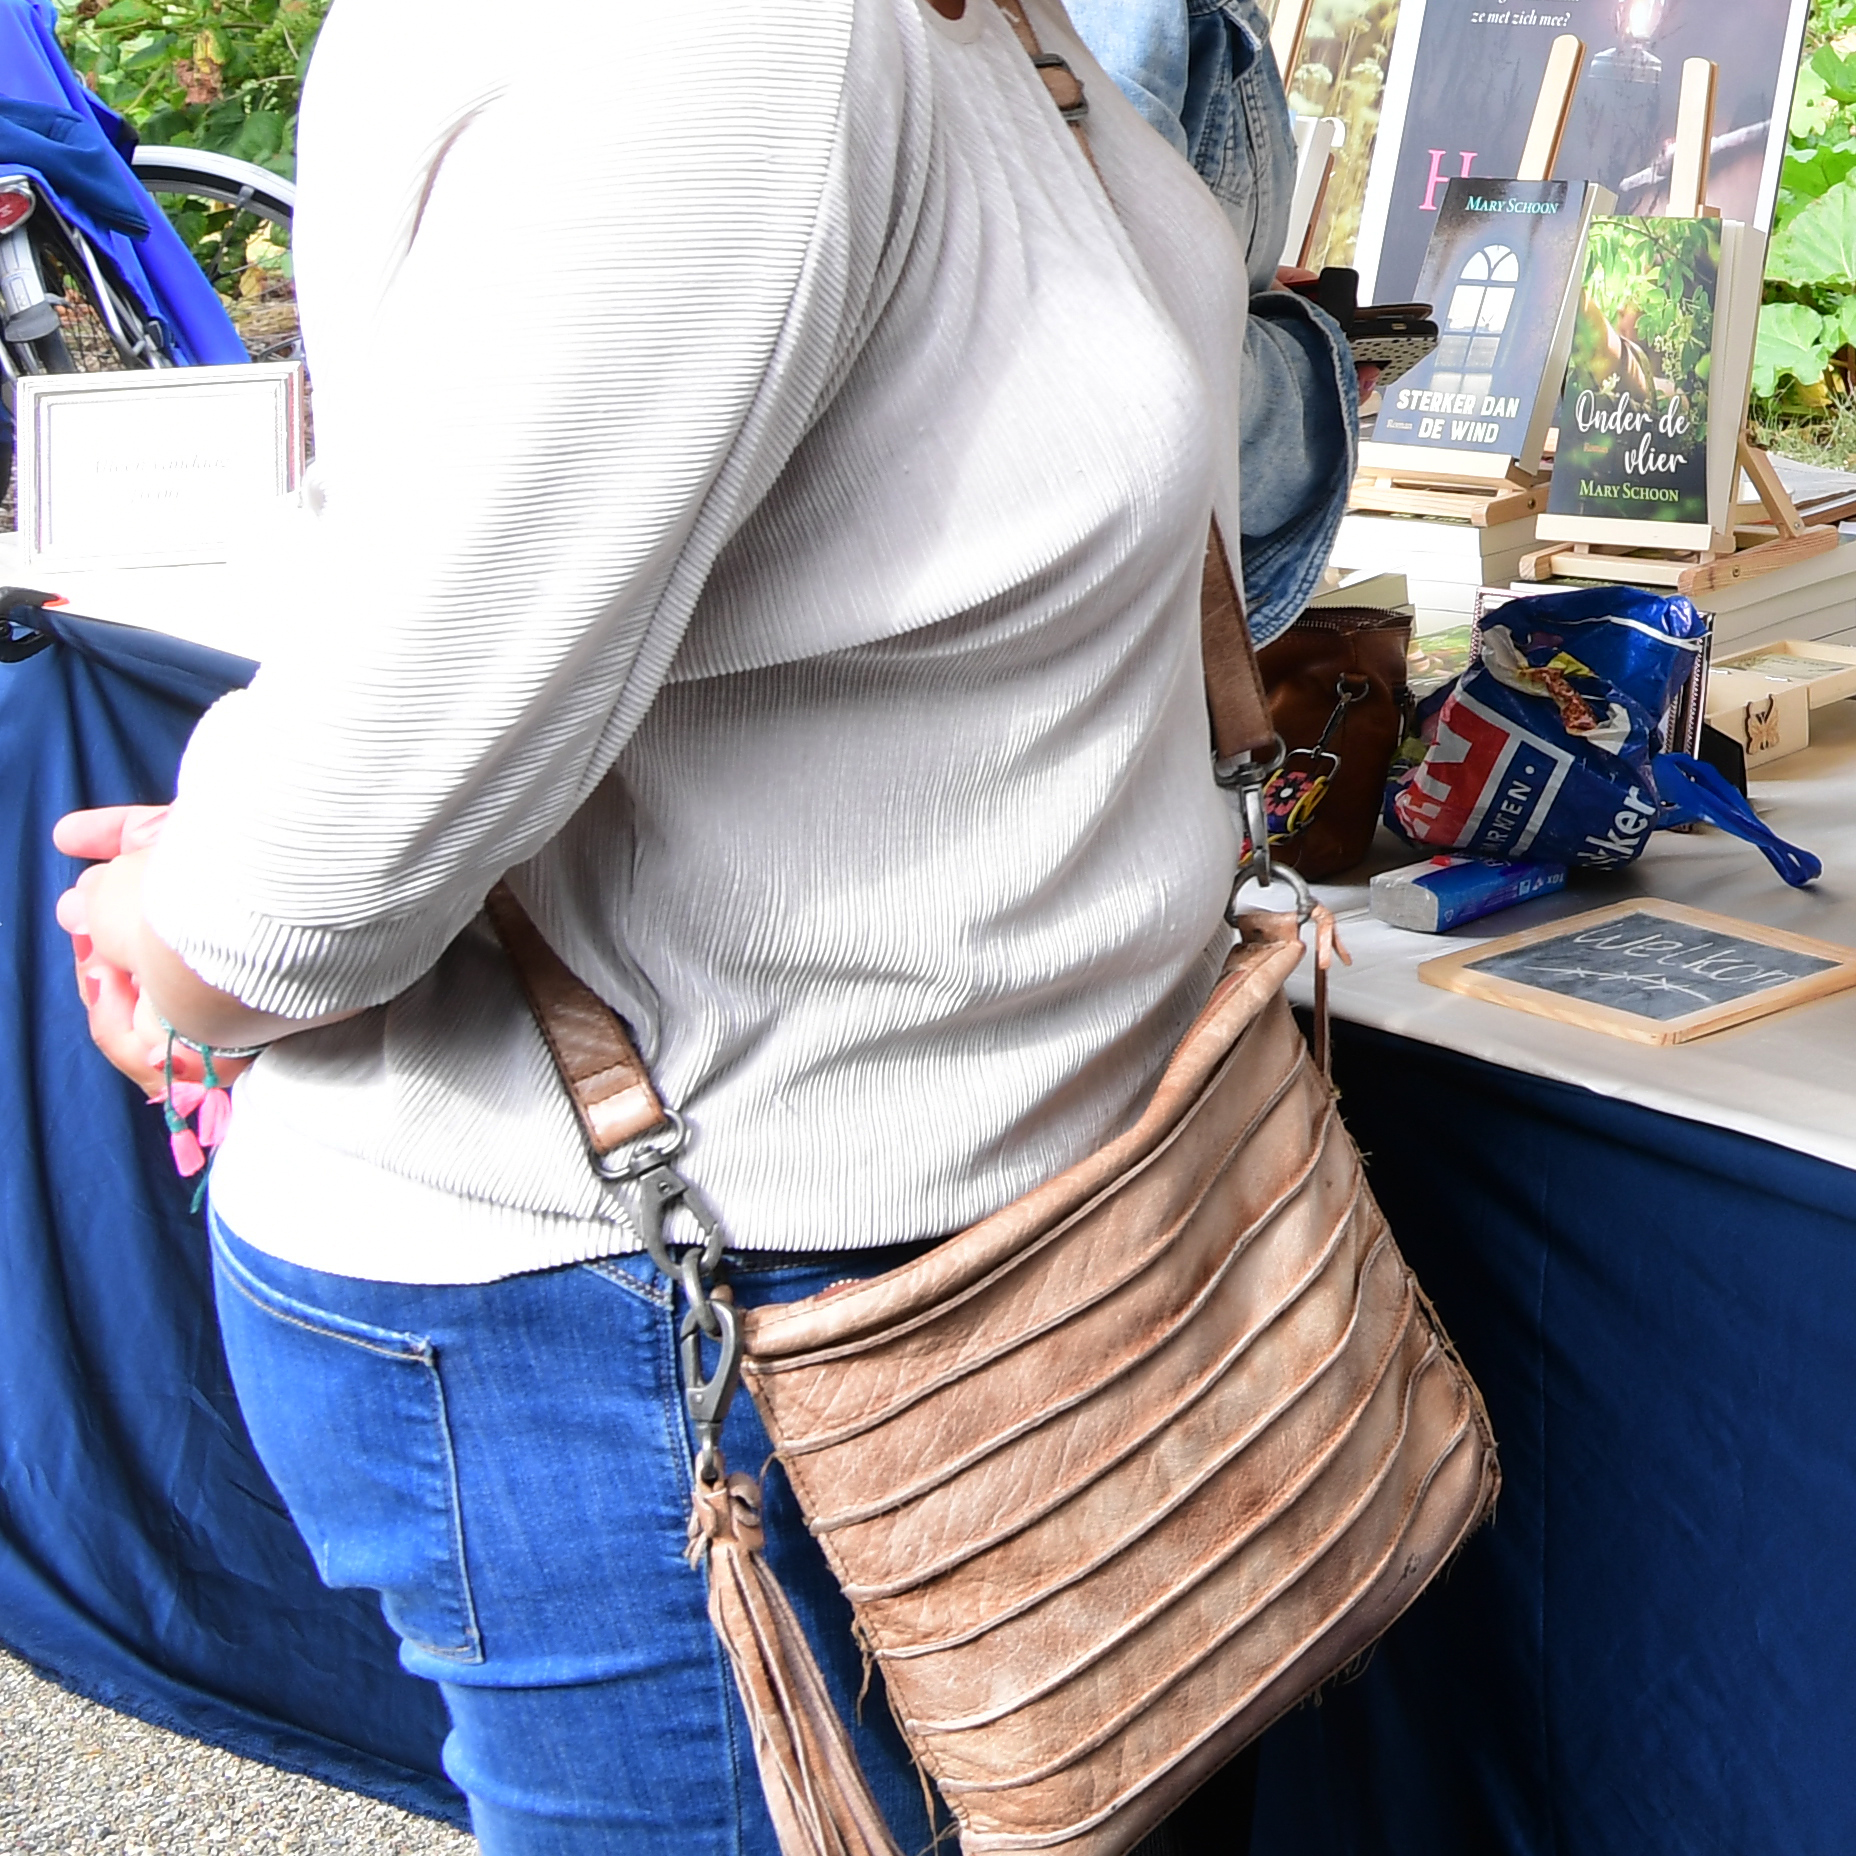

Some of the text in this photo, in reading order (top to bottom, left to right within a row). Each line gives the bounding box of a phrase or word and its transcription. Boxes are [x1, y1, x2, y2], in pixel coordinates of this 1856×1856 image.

[1470, 8, 1571, 27] ze met zich mee?
[1465, 194, 1560, 216] MARY SCHOON
[1396, 389, 1521, 419] STERKER DAN
[1575, 389, 1691, 439] Onder de
[1386, 418, 1413, 430] Roman
[1418, 417, 1500, 444] DE WIND
[1623, 432, 1689, 476] vlier
[1578, 479, 1680, 503] MARY SCHOON
